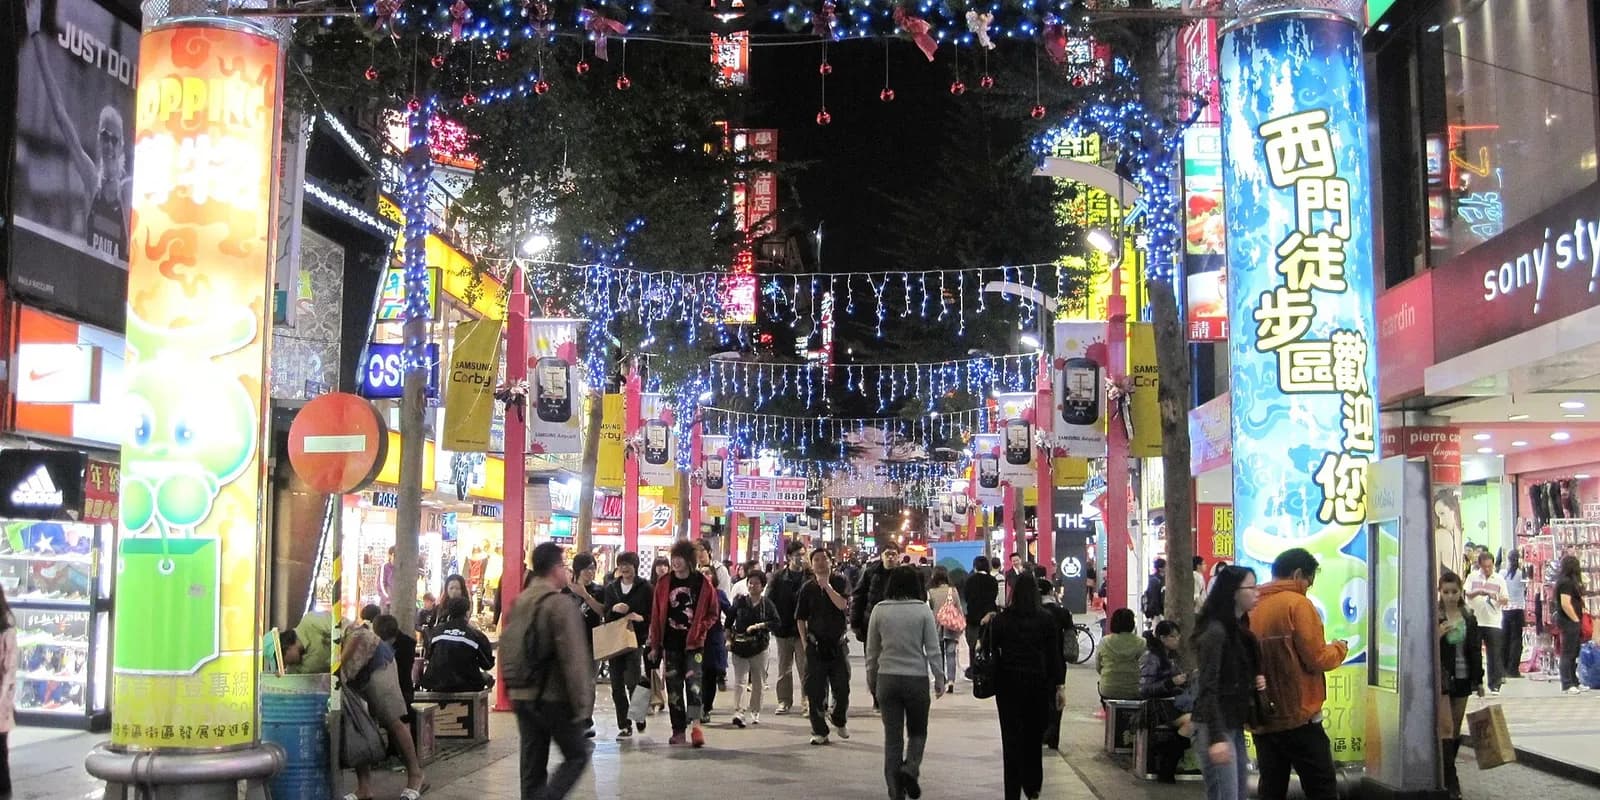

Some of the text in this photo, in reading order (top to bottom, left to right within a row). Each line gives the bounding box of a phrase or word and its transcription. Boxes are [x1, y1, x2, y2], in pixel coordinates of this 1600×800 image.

[58, 22, 105, 68] JUST
[108, 48, 130, 86] DO
[93, 233, 119, 258] PAULA
[1253, 109, 1350, 393] 西門徒步區
[1484, 228, 1550, 314] sony
[455, 362, 492, 371] SAMSUNG
[453, 371, 491, 388] Corby
[1312, 329, 1374, 524] 歡迎您
[1410, 431, 1446, 445] pierre
[1055, 512, 1087, 528] THE
